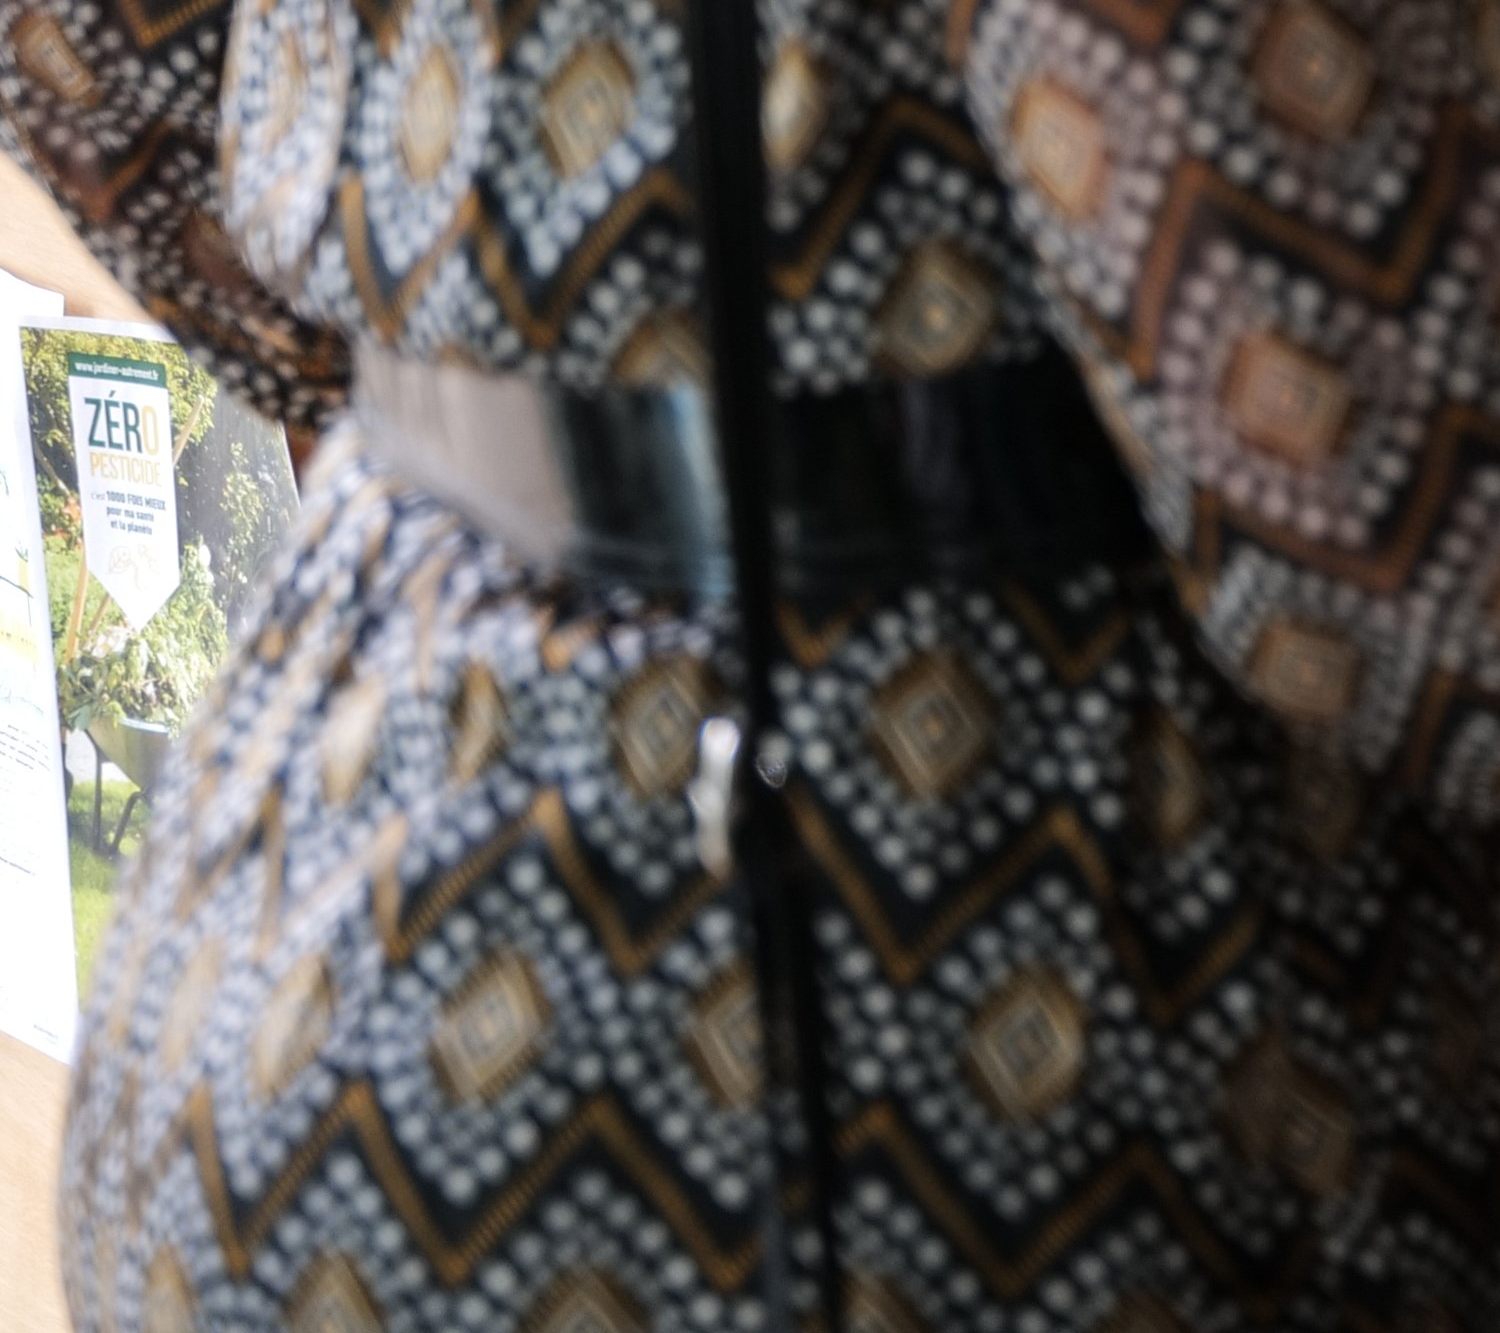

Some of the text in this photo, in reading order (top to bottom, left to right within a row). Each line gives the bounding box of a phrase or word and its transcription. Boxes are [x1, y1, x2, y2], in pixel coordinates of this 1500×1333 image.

[84, 390, 161, 456] ZÉRO
[89, 451, 162, 488] PESTICIDE
[106, 490, 127, 504] 1000
[127, 492, 144, 507] FOIS
[106, 505, 122, 518] pour
[124, 508, 135, 519] ma
